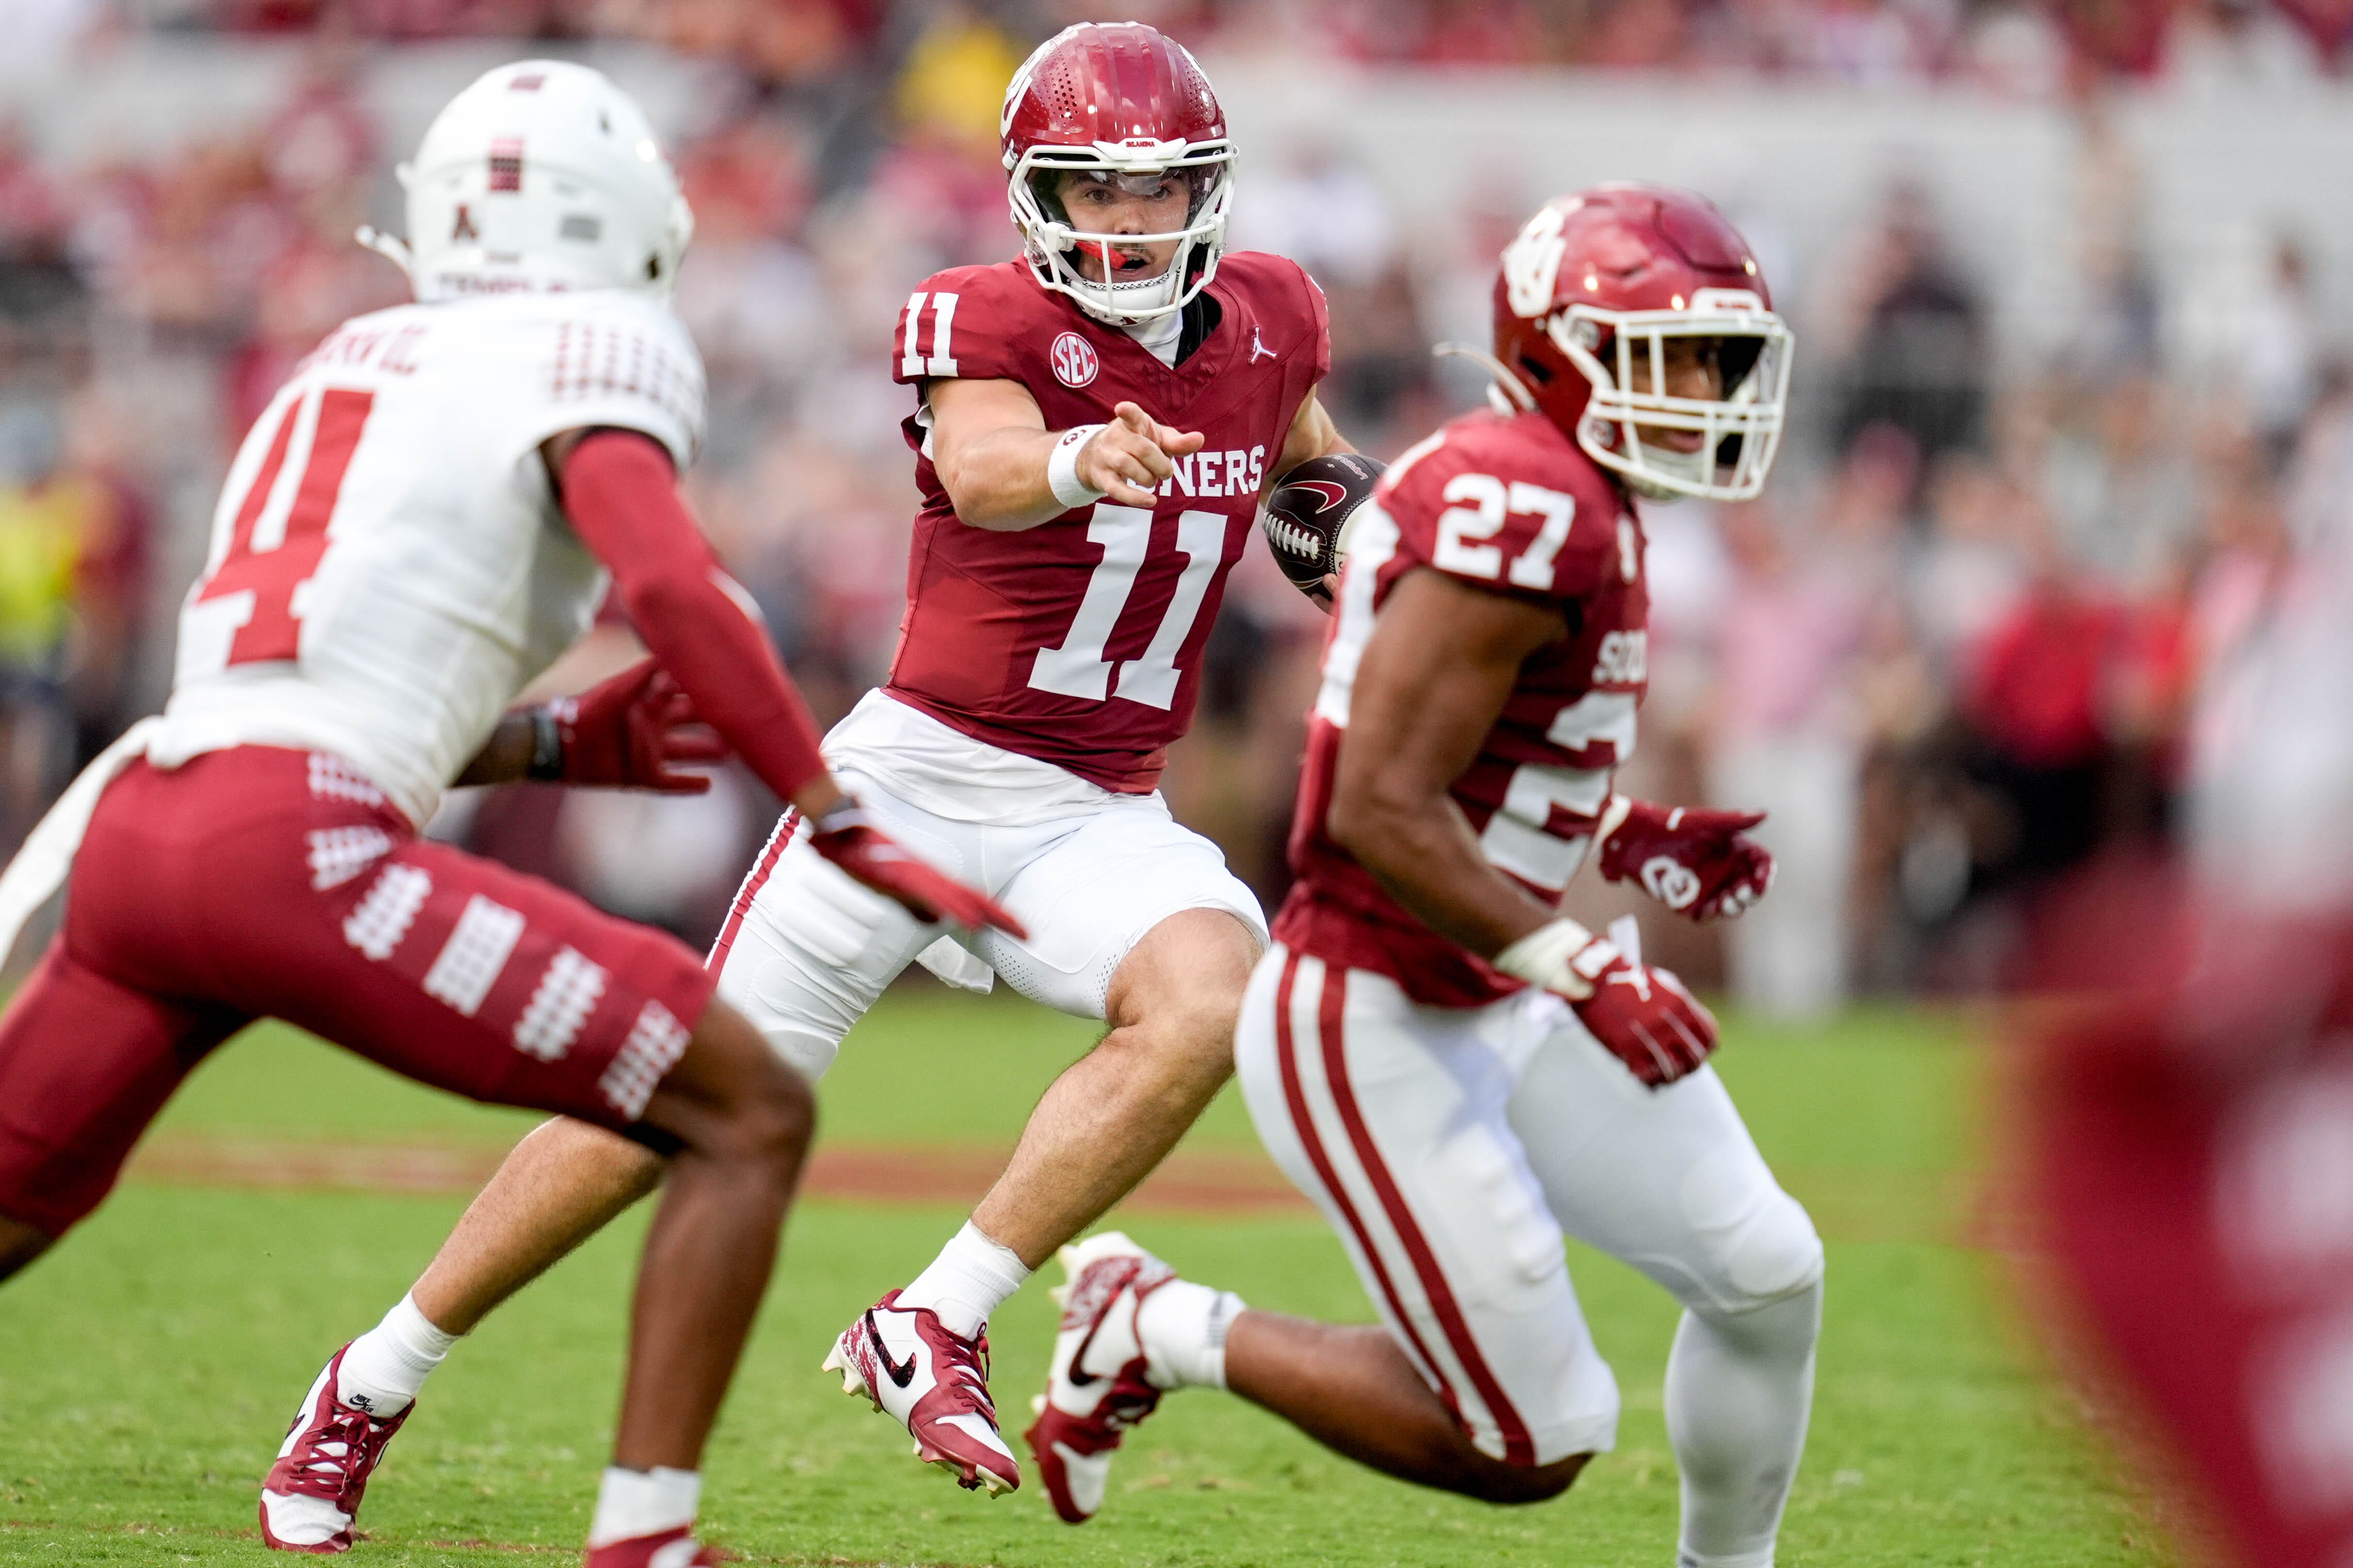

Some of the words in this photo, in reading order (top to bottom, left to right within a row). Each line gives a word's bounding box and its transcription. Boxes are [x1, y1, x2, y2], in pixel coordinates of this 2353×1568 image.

[902, 292, 959, 377] 11
[1055, 336, 1095, 384] SEC
[195, 387, 377, 666] 4
[1432, 472, 1575, 591] 27
[1027, 503, 1228, 711] 11
[354, 1394, 372, 1403] NIKE
[361, 1404, 374, 1413] AIR
